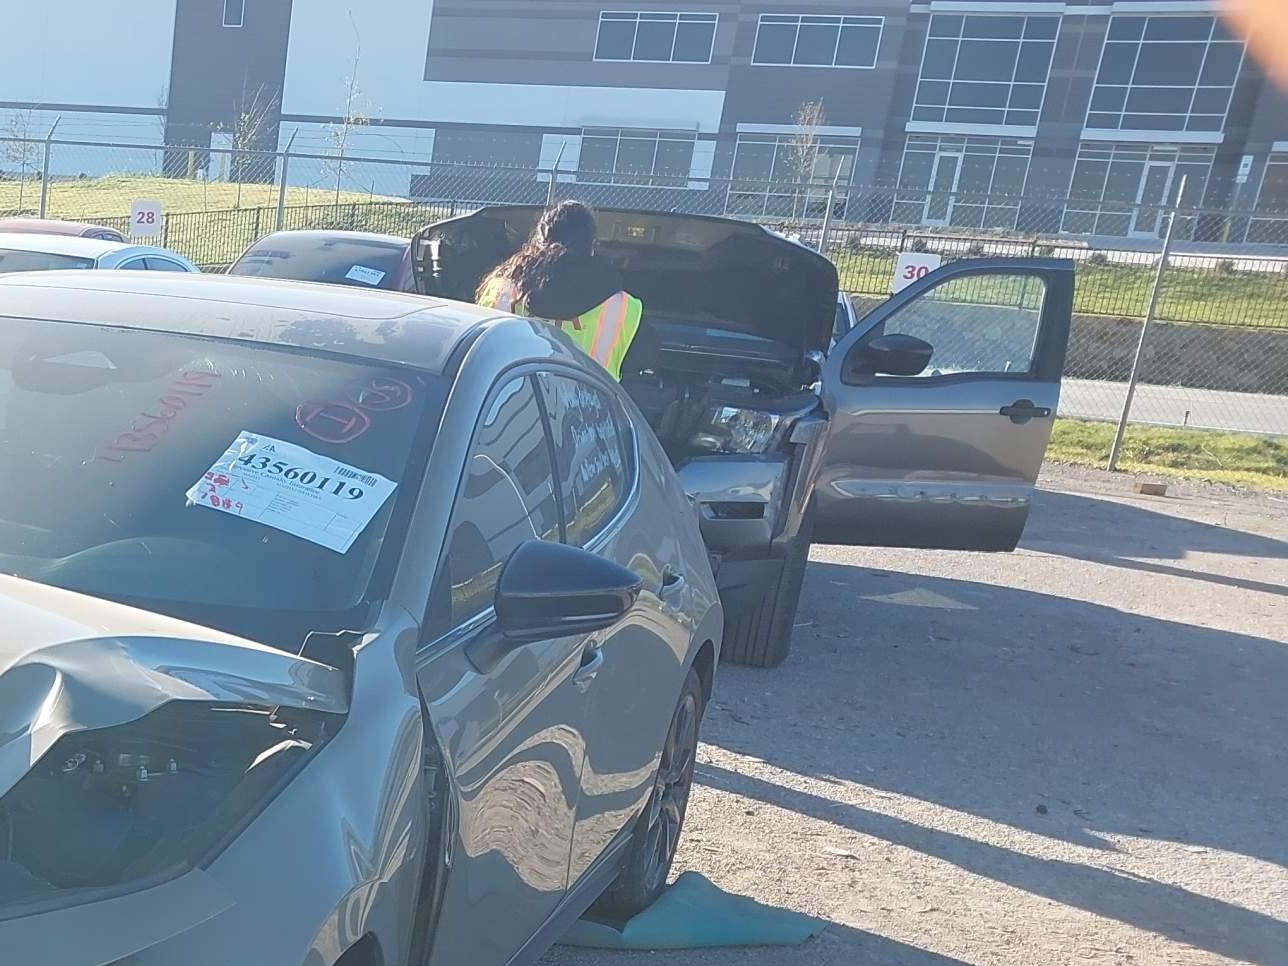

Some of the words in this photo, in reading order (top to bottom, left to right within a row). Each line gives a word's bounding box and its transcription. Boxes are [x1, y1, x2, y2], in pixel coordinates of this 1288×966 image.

[136, 210, 155, 225] 28
[902, 264, 929, 280] 30
[238, 453, 365, 502] 43560119
